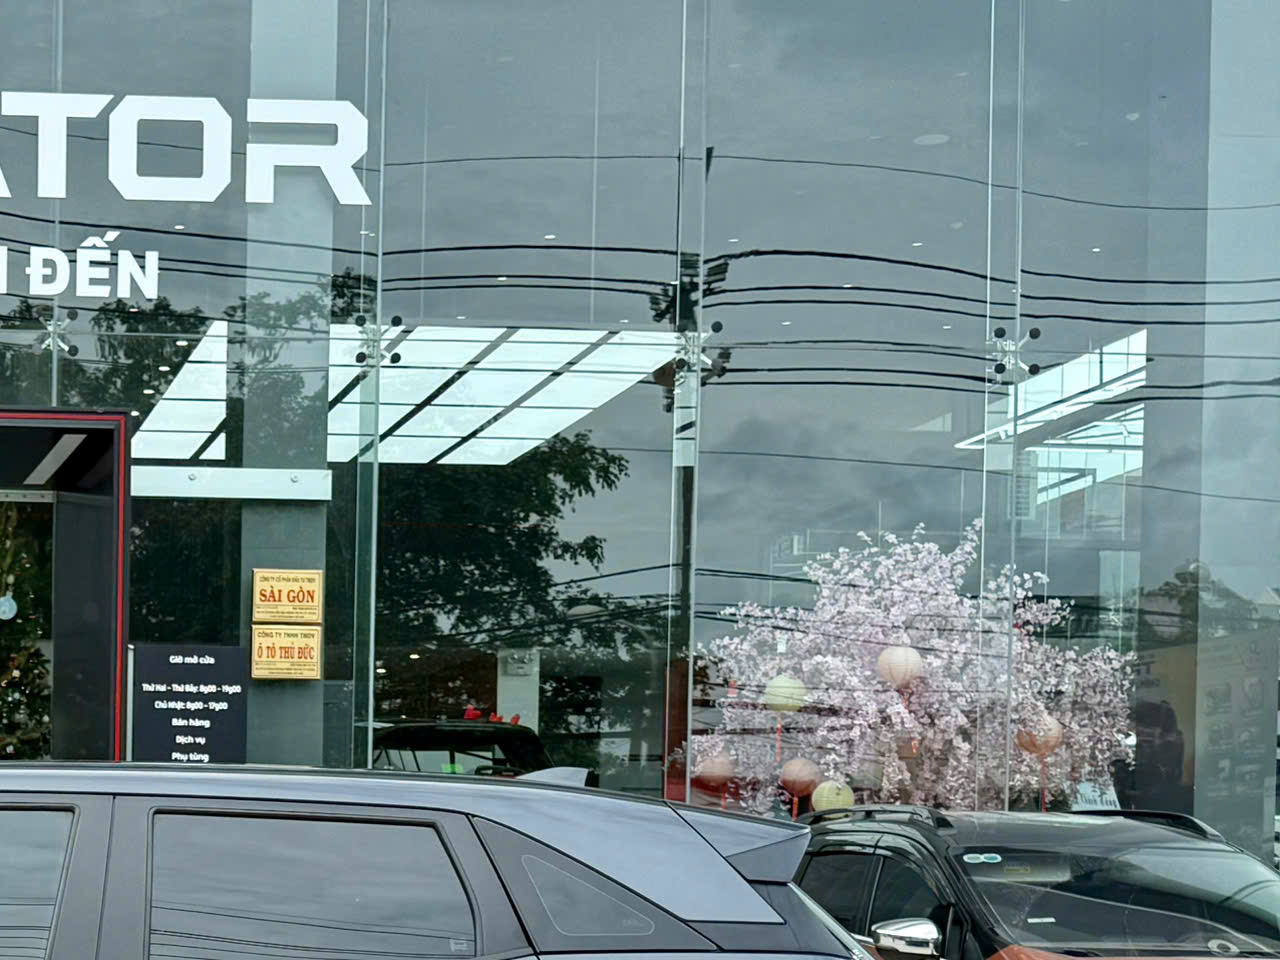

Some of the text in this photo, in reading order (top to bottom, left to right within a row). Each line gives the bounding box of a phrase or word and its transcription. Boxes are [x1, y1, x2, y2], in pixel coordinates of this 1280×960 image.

[25, 231, 160, 299] ĐẾN
[259, 585, 316, 603] SÀI GÒN
[175, 735, 206, 745] Dịch vụ
[171, 752, 209, 763] Phụ tùng
